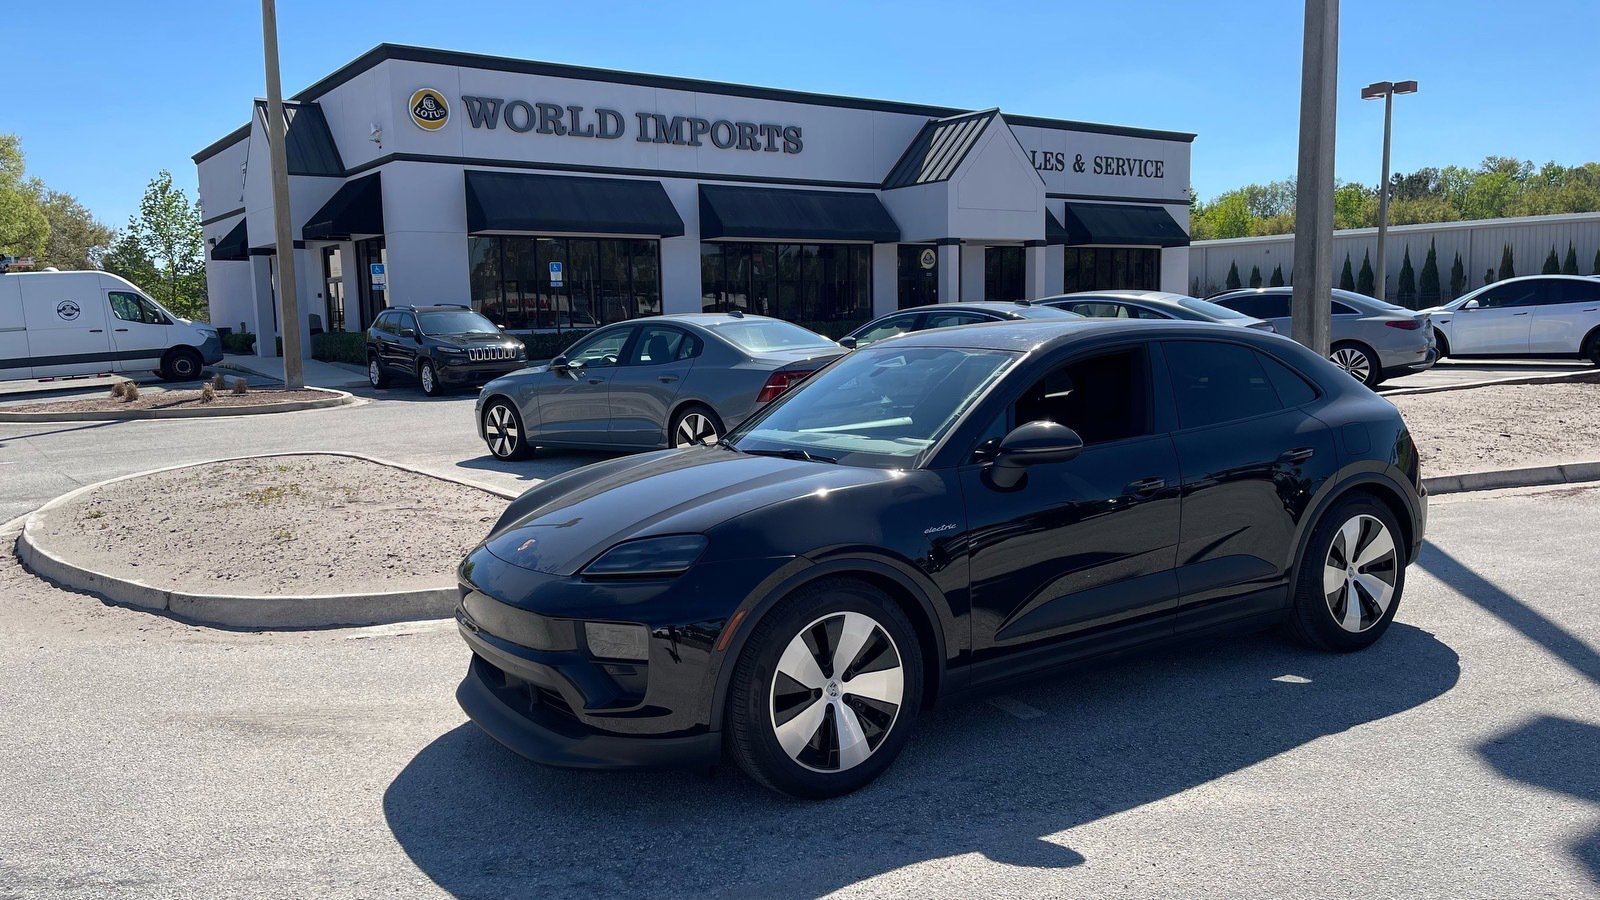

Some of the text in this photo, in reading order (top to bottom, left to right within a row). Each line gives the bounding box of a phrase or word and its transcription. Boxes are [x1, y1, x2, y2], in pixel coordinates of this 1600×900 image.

[415, 107, 446, 119] LOTUS
[462, 95, 804, 155] WORLD IMPORTS
[1030, 150, 1165, 179] LES & SERVICE
[924, 523, 957, 534] electric
